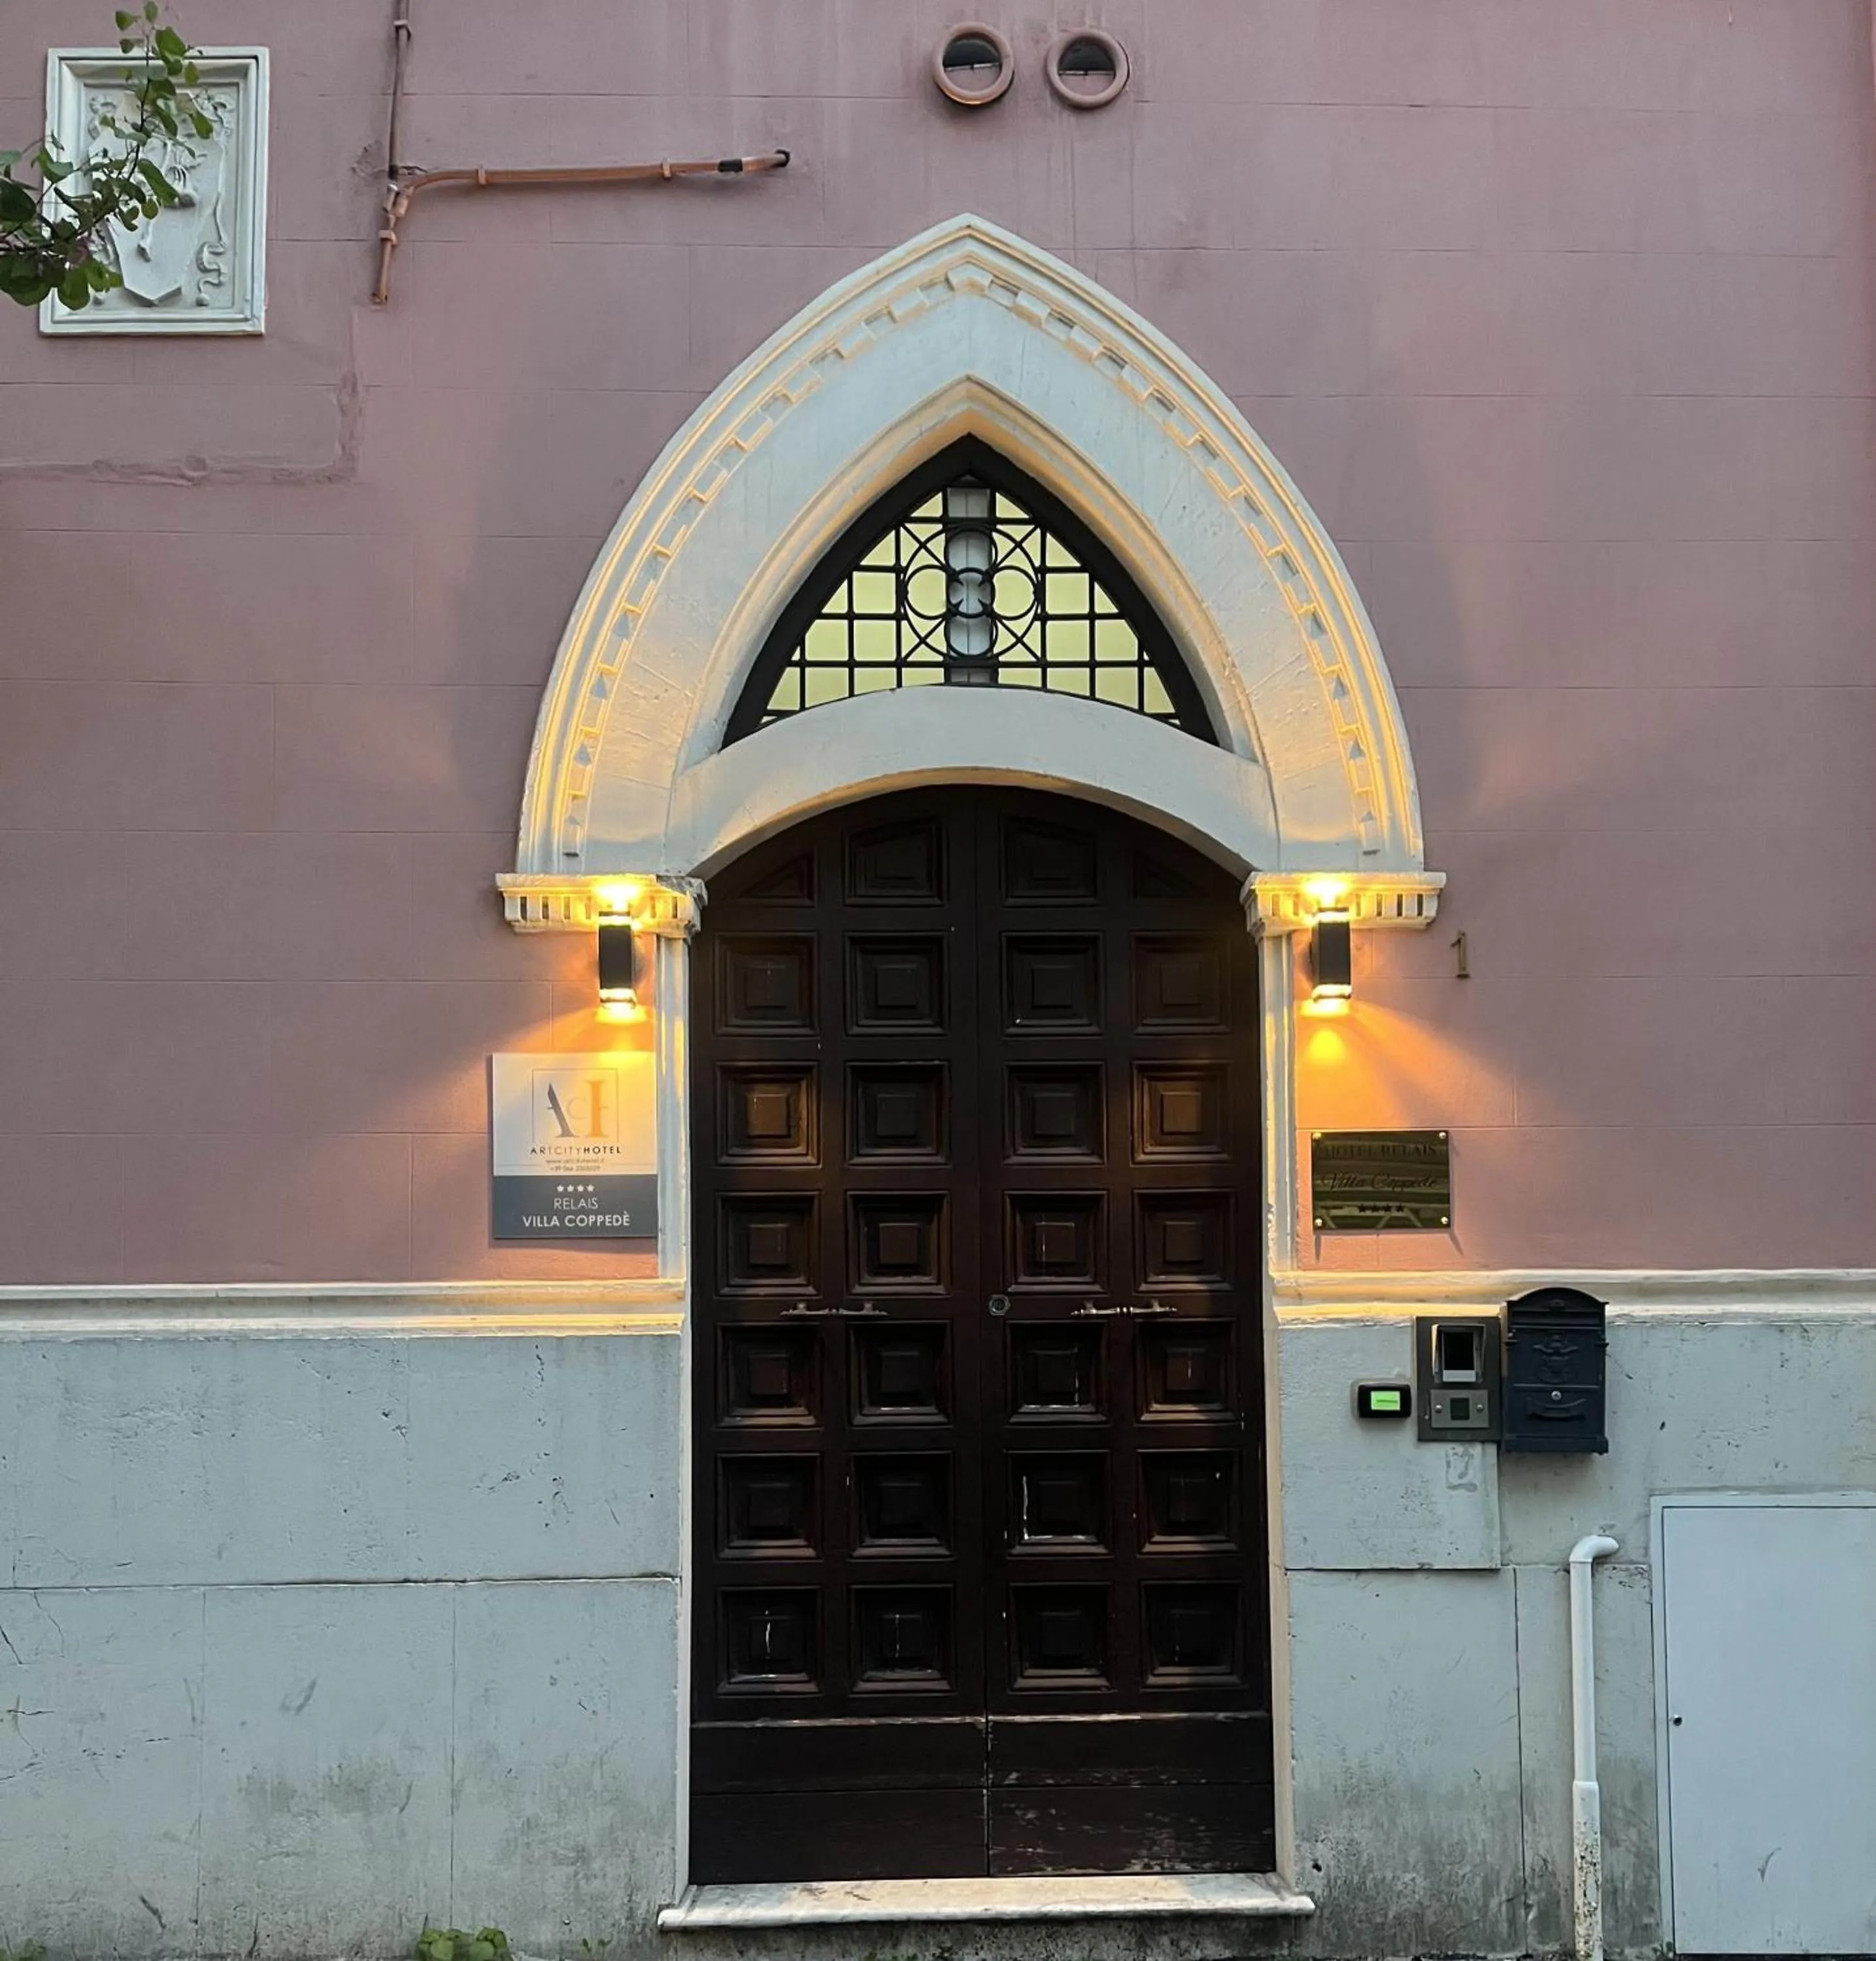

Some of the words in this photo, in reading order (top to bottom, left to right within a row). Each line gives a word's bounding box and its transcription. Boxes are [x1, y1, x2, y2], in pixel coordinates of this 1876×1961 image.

[1450, 930, 1471, 980] 1
[1380, 1144, 1436, 1158] RELAIS
[1321, 1171, 1364, 1190] Villa
[554, 1197, 598, 1209] RELAIS
[522, 1215, 560, 1228] VILLA
[564, 1211, 630, 1227] COPPEDÈ
